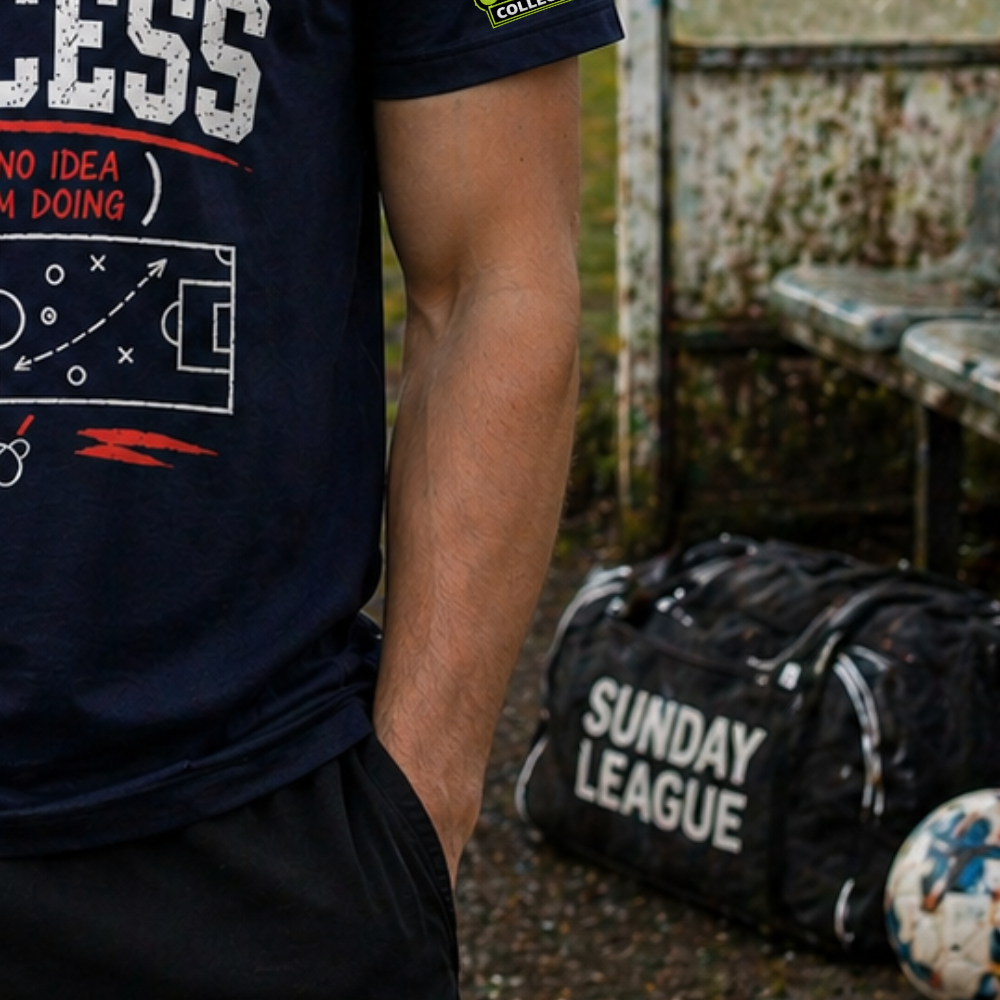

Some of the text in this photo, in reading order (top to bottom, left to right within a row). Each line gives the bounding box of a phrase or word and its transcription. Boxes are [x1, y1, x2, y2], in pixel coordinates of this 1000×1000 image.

[50, 149, 119, 180] IDEA
[32, 189, 125, 220] DOING
[582, 676, 767, 784] SUNDAY
[574, 739, 748, 854] LEAGUE
